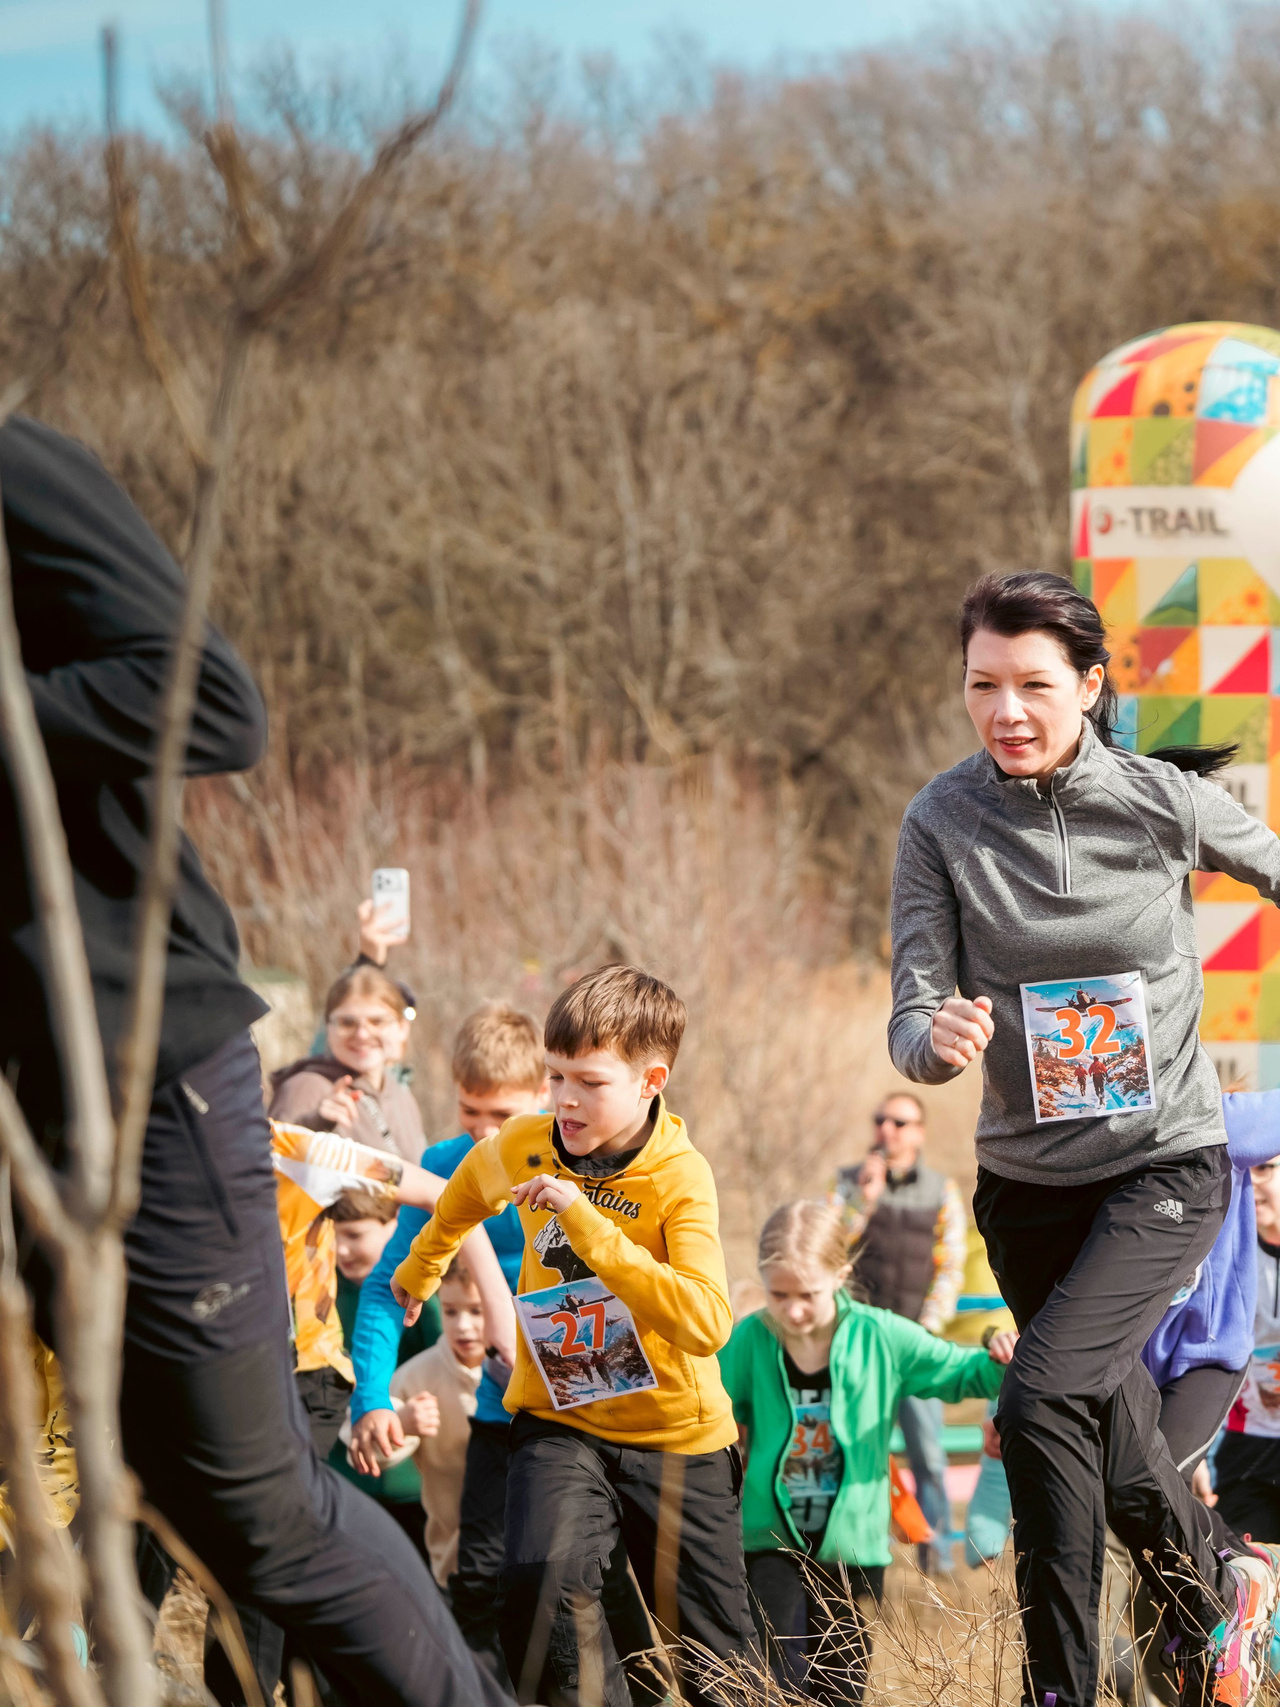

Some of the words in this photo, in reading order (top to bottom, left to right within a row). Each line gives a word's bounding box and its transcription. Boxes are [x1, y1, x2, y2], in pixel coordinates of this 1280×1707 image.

[1054, 1003, 1122, 1060] 32
[1153, 1202, 1184, 1225] adidas
[549, 1300, 607, 1358] 27
[790, 1421, 834, 1459] 34
